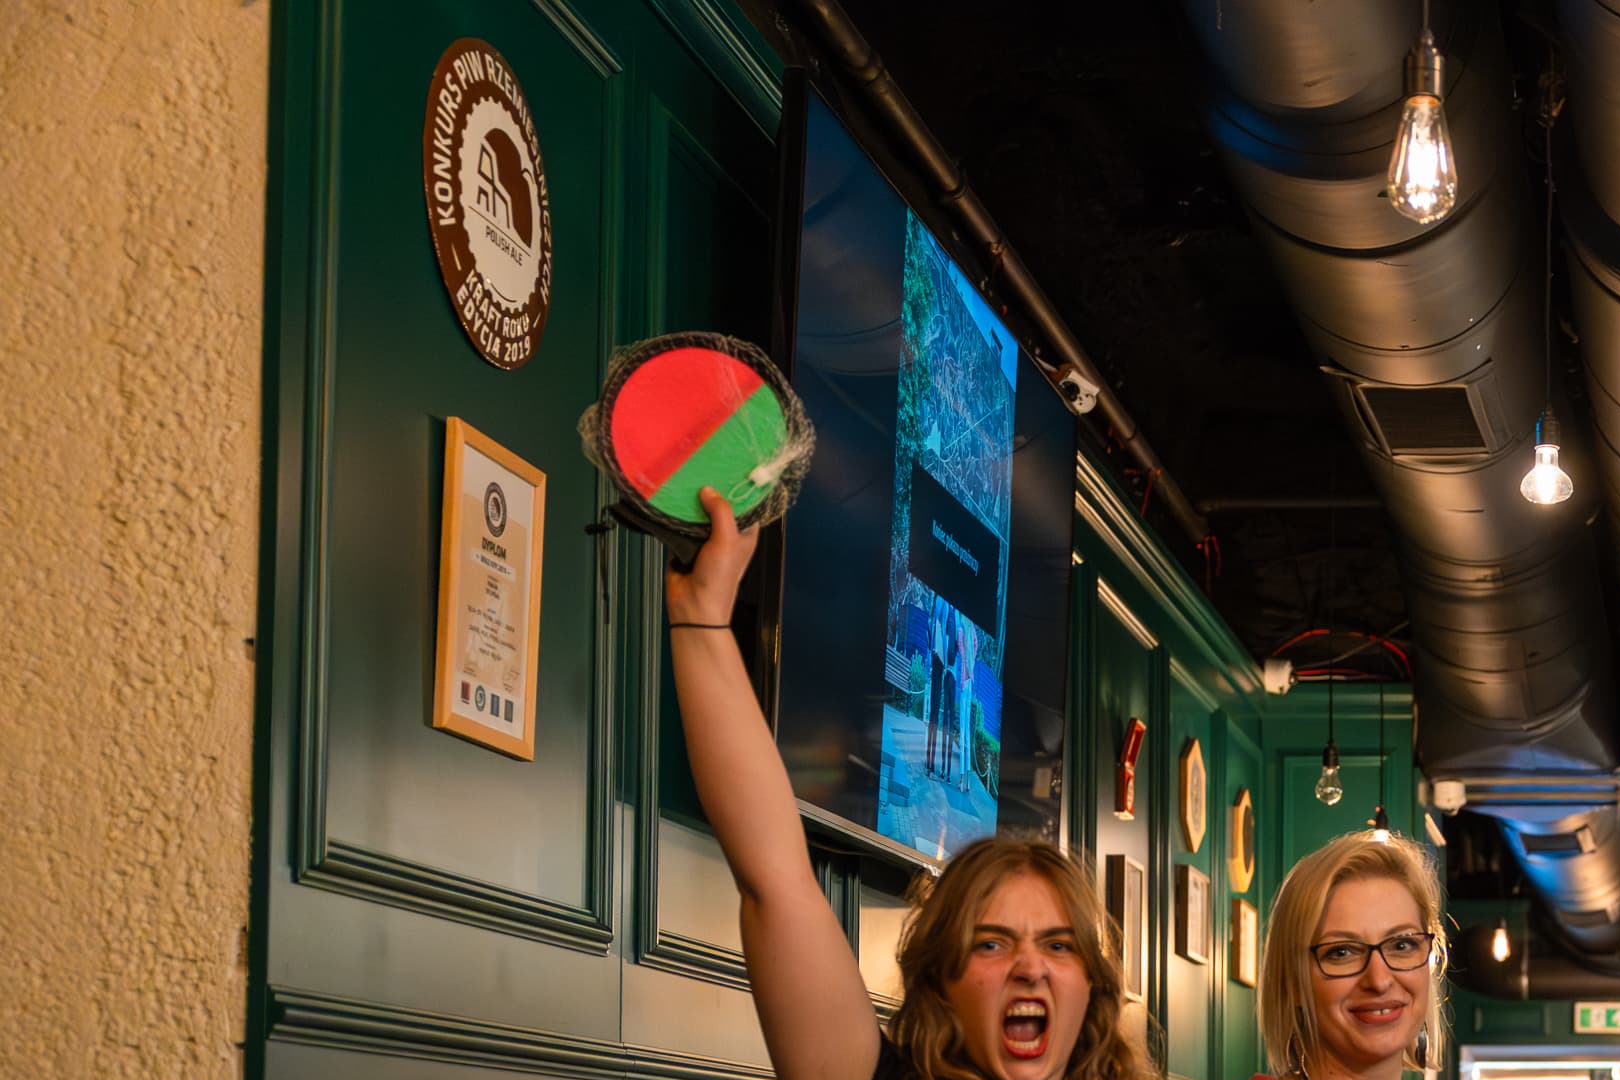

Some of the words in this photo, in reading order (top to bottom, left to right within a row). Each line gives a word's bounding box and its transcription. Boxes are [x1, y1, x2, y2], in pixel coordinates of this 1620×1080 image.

[433, 72, 462, 226] KONKURS
[453, 50, 485, 90] PIW
[485, 225, 510, 256] POLISH
[510, 247, 523, 267] ALE
[466, 269, 502, 331] KRAFT
[502, 313, 530, 338] ROKU
[503, 335, 531, 362] 2019
[482, 536, 507, 561] DYPLOM
